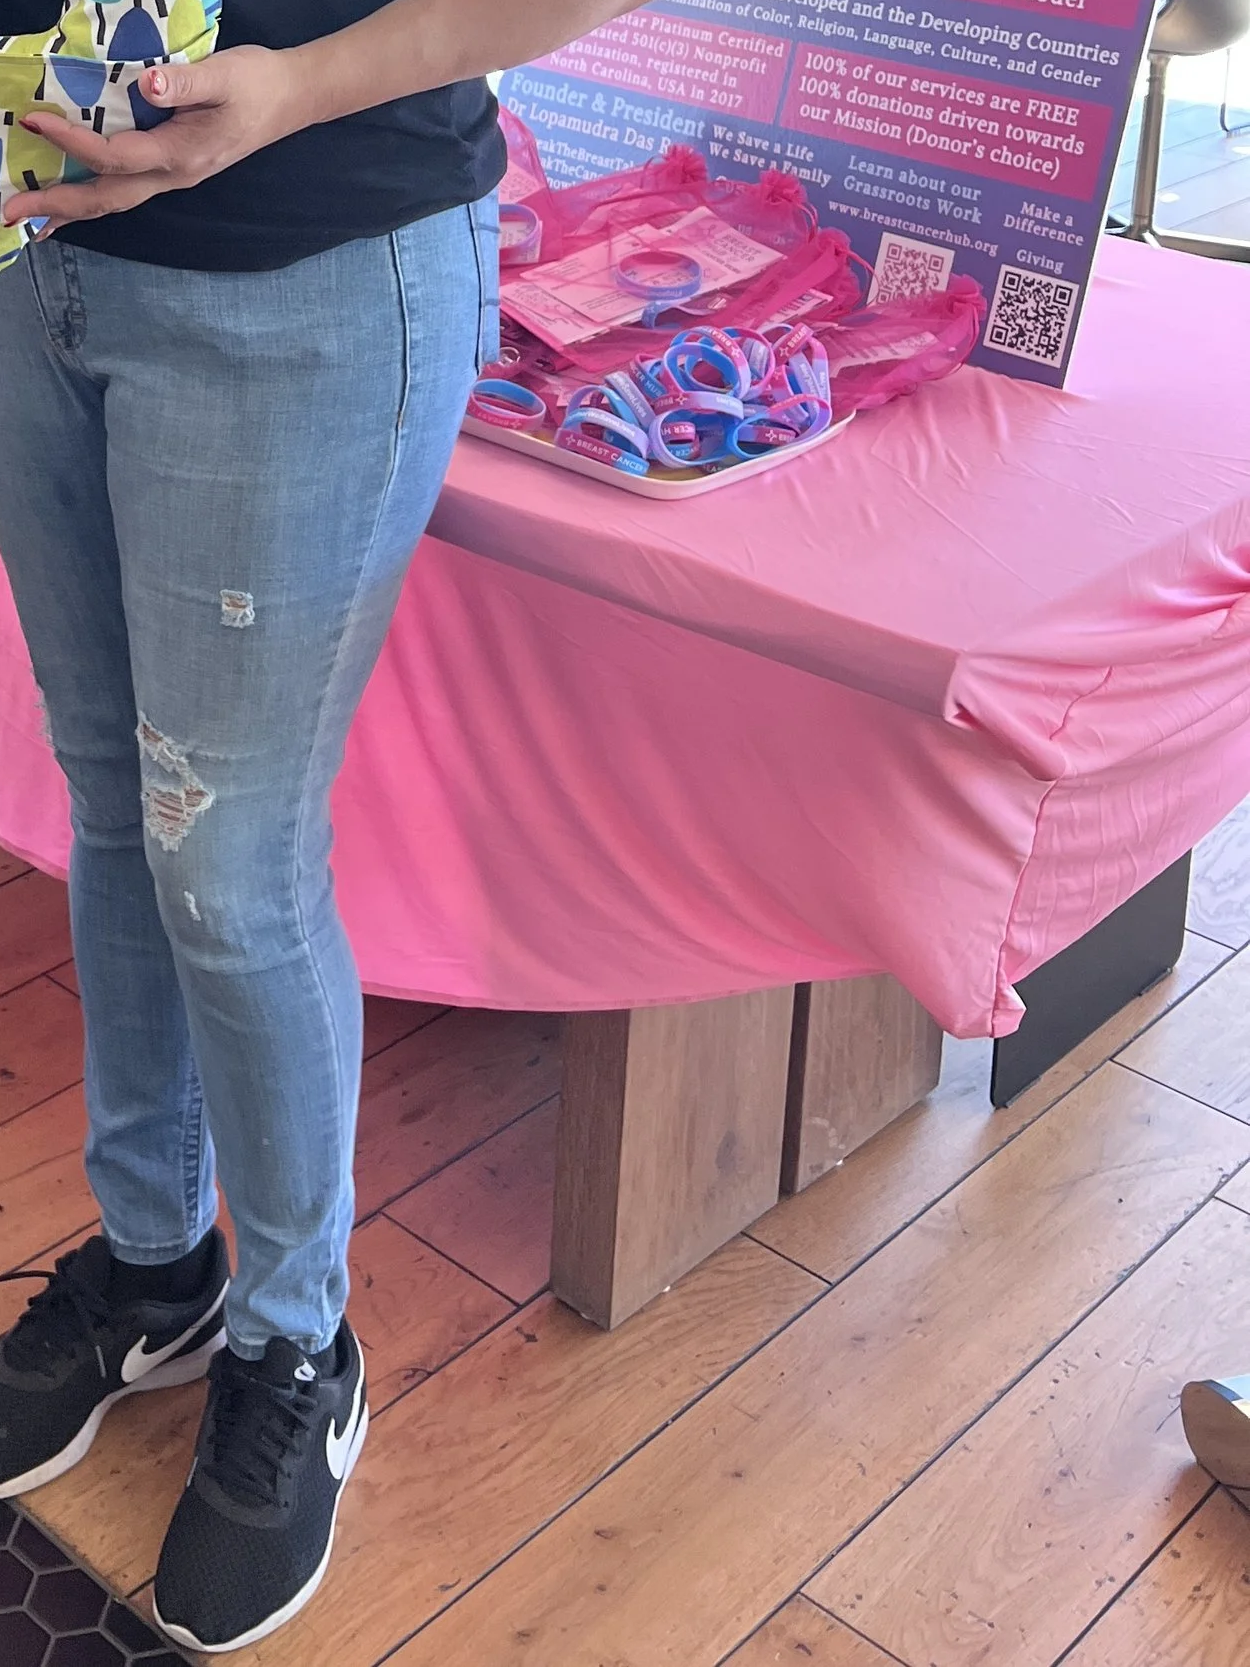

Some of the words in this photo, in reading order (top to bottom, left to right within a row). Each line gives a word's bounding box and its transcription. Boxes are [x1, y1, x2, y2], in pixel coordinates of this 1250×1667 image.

[631, 30, 690, 59] 501(c)(3)
[693, 46, 767, 75] Nonprofit
[650, 16, 713, 43] Platinum
[717, 31, 785, 58] Certified
[753, 6, 794, 29] Color,
[797, 14, 859, 41] Religion,
[863, 27, 936, 57] Language,
[940, 43, 1002, 71] Culture,
[1006, 59, 1037, 76] and
[1041, 63, 1102, 89] Gender
[852, 2, 885, 20] and
[888, 5, 916, 26] the
[918, 11, 1023, 51] Developing
[1026, 32, 1120, 66] Countries
[549, 53, 587, 73] North
[591, 63, 652, 91] Carolina,
[657, 77, 686, 96] USA
[709, 88, 744, 109] 2017
[646, 58, 719, 83] registered
[805, 52, 848, 77] 100%
[852, 64, 874, 82] of
[874, 72, 908, 89] our
[910, 77, 986, 107] services
[989, 95, 1022, 114] are
[1025, 98, 1080, 127] FREE
[507, 97, 528, 117] Dr
[529, 102, 619, 142] Lopamudra
[623, 127, 654, 152] Das
[510, 72, 588, 108] Founder
[610, 95, 706, 139] President
[798, 75, 842, 100] 100%
[846, 86, 935, 121] donations
[938, 106, 1000, 136] driven
[1005, 122, 1085, 156] towards
[709, 141, 730, 159] We
[733, 148, 766, 169] Save
[782, 160, 832, 189] Family
[712, 124, 734, 142] We
[737, 131, 770, 151] Save
[786, 143, 815, 163] Life
[799, 103, 831, 122] our
[833, 107, 902, 140] Mission
[989, 145, 1060, 181] choice)
[843, 174, 931, 211] Grassroots
[936, 197, 983, 225] Work
[848, 154, 894, 180] Learn
[898, 168, 947, 194] about
[950, 183, 982, 202] our
[827, 199, 999, 258] www.breastcancerhub.org
[1002, 213, 1085, 247] Difference
[1020, 201, 1061, 224] Make
[1064, 214, 1074, 227] a
[1016, 248, 1064, 275] Giving
[576, 439, 610, 457] BREAST
